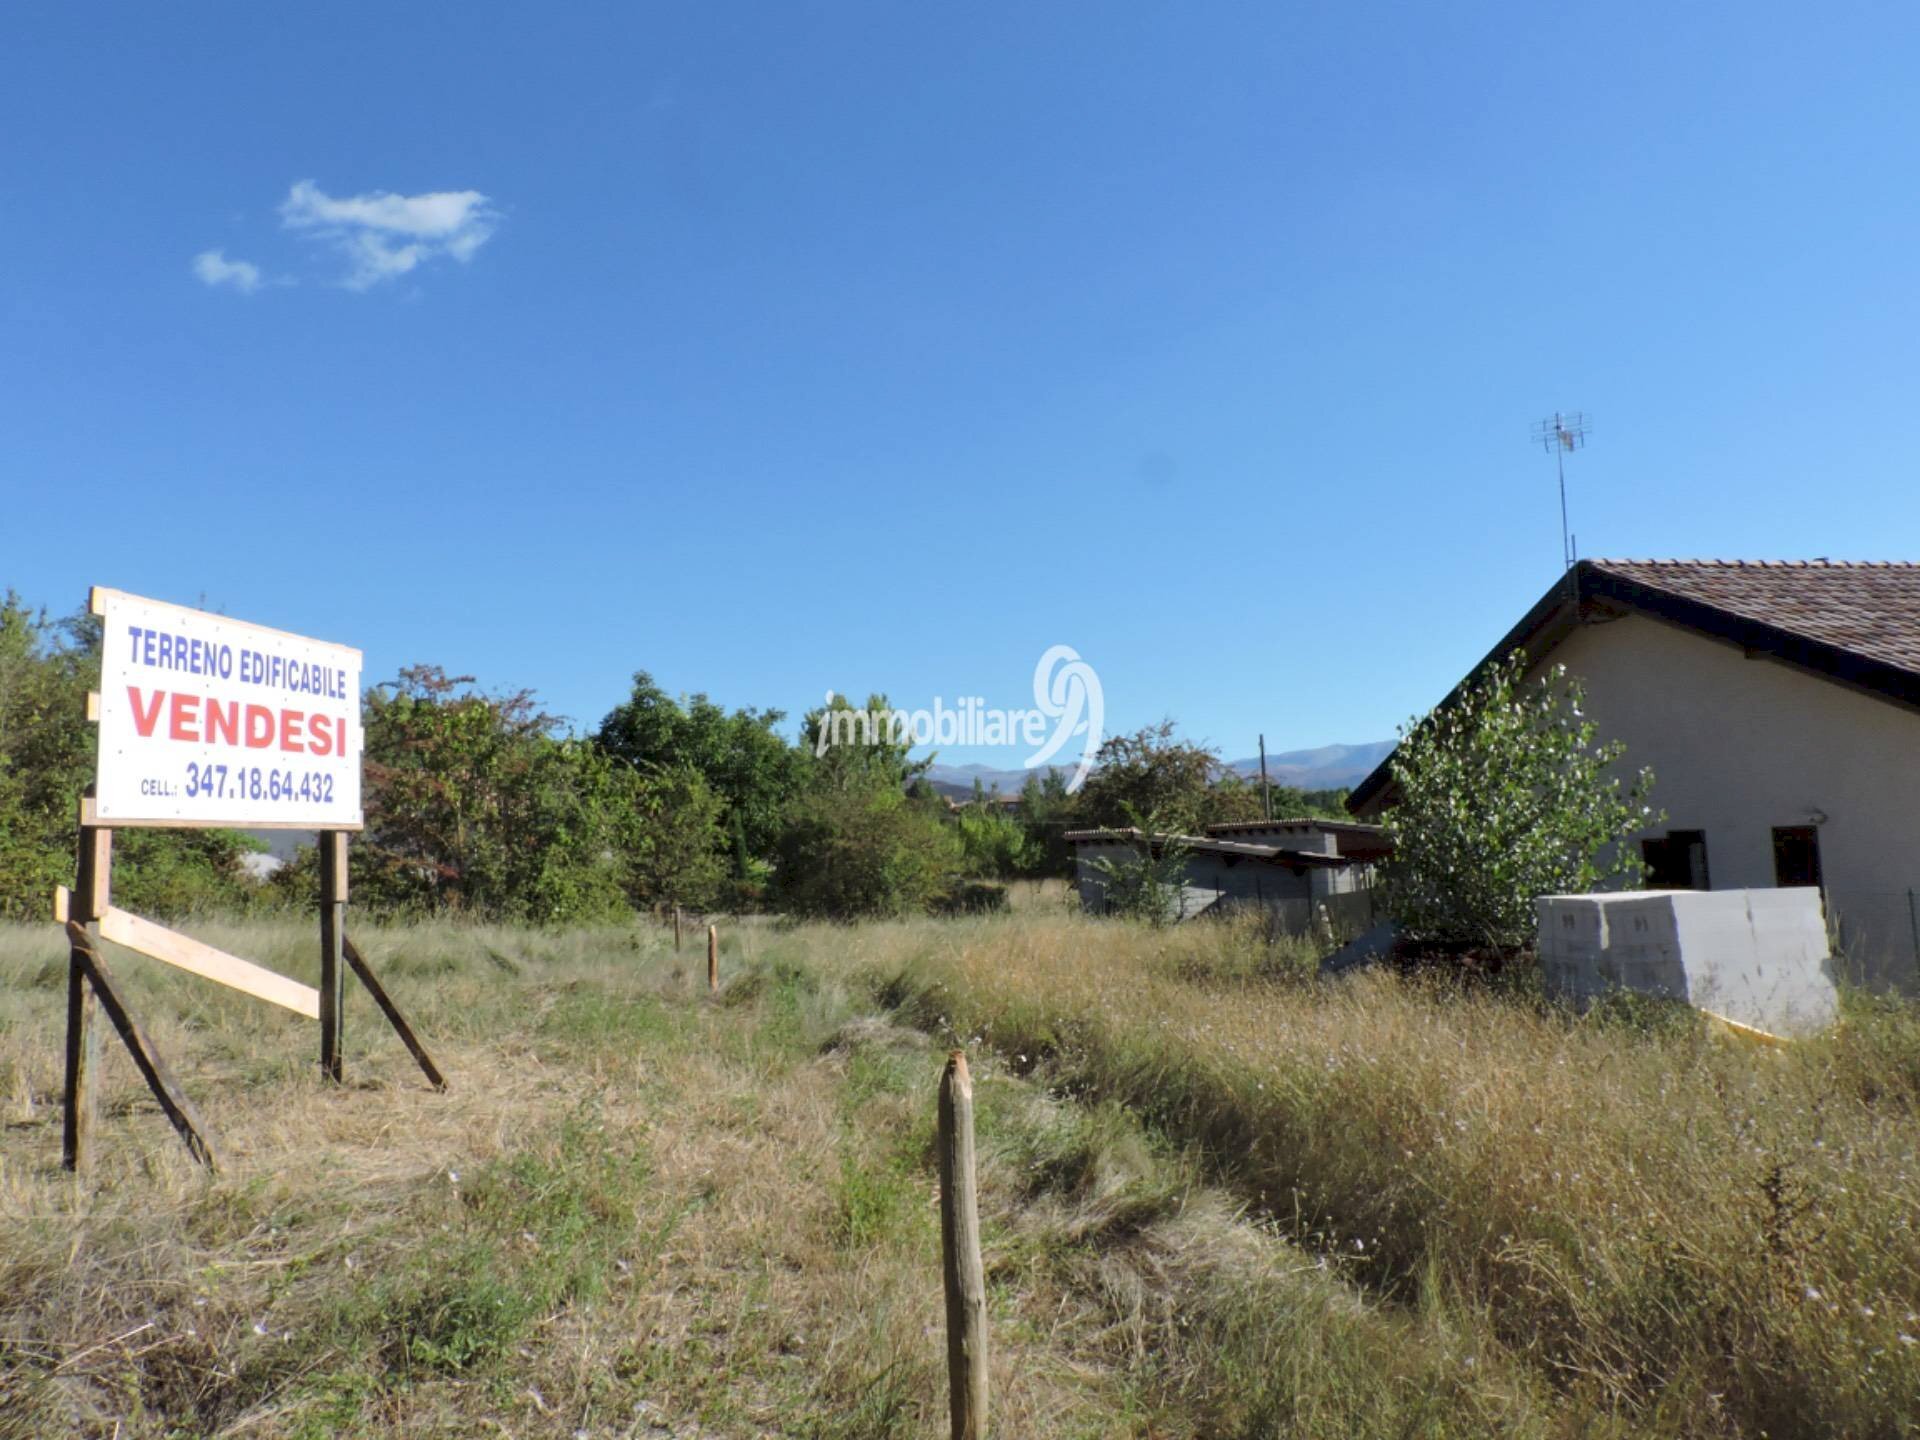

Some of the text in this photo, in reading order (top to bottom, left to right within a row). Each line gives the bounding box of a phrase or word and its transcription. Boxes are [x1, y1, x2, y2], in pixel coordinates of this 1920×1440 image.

[128, 626, 346, 699] TERRENO EDIFICABILE
[127, 686, 346, 757] VENDESI
[186, 762, 334, 802] 347.18.64.432
